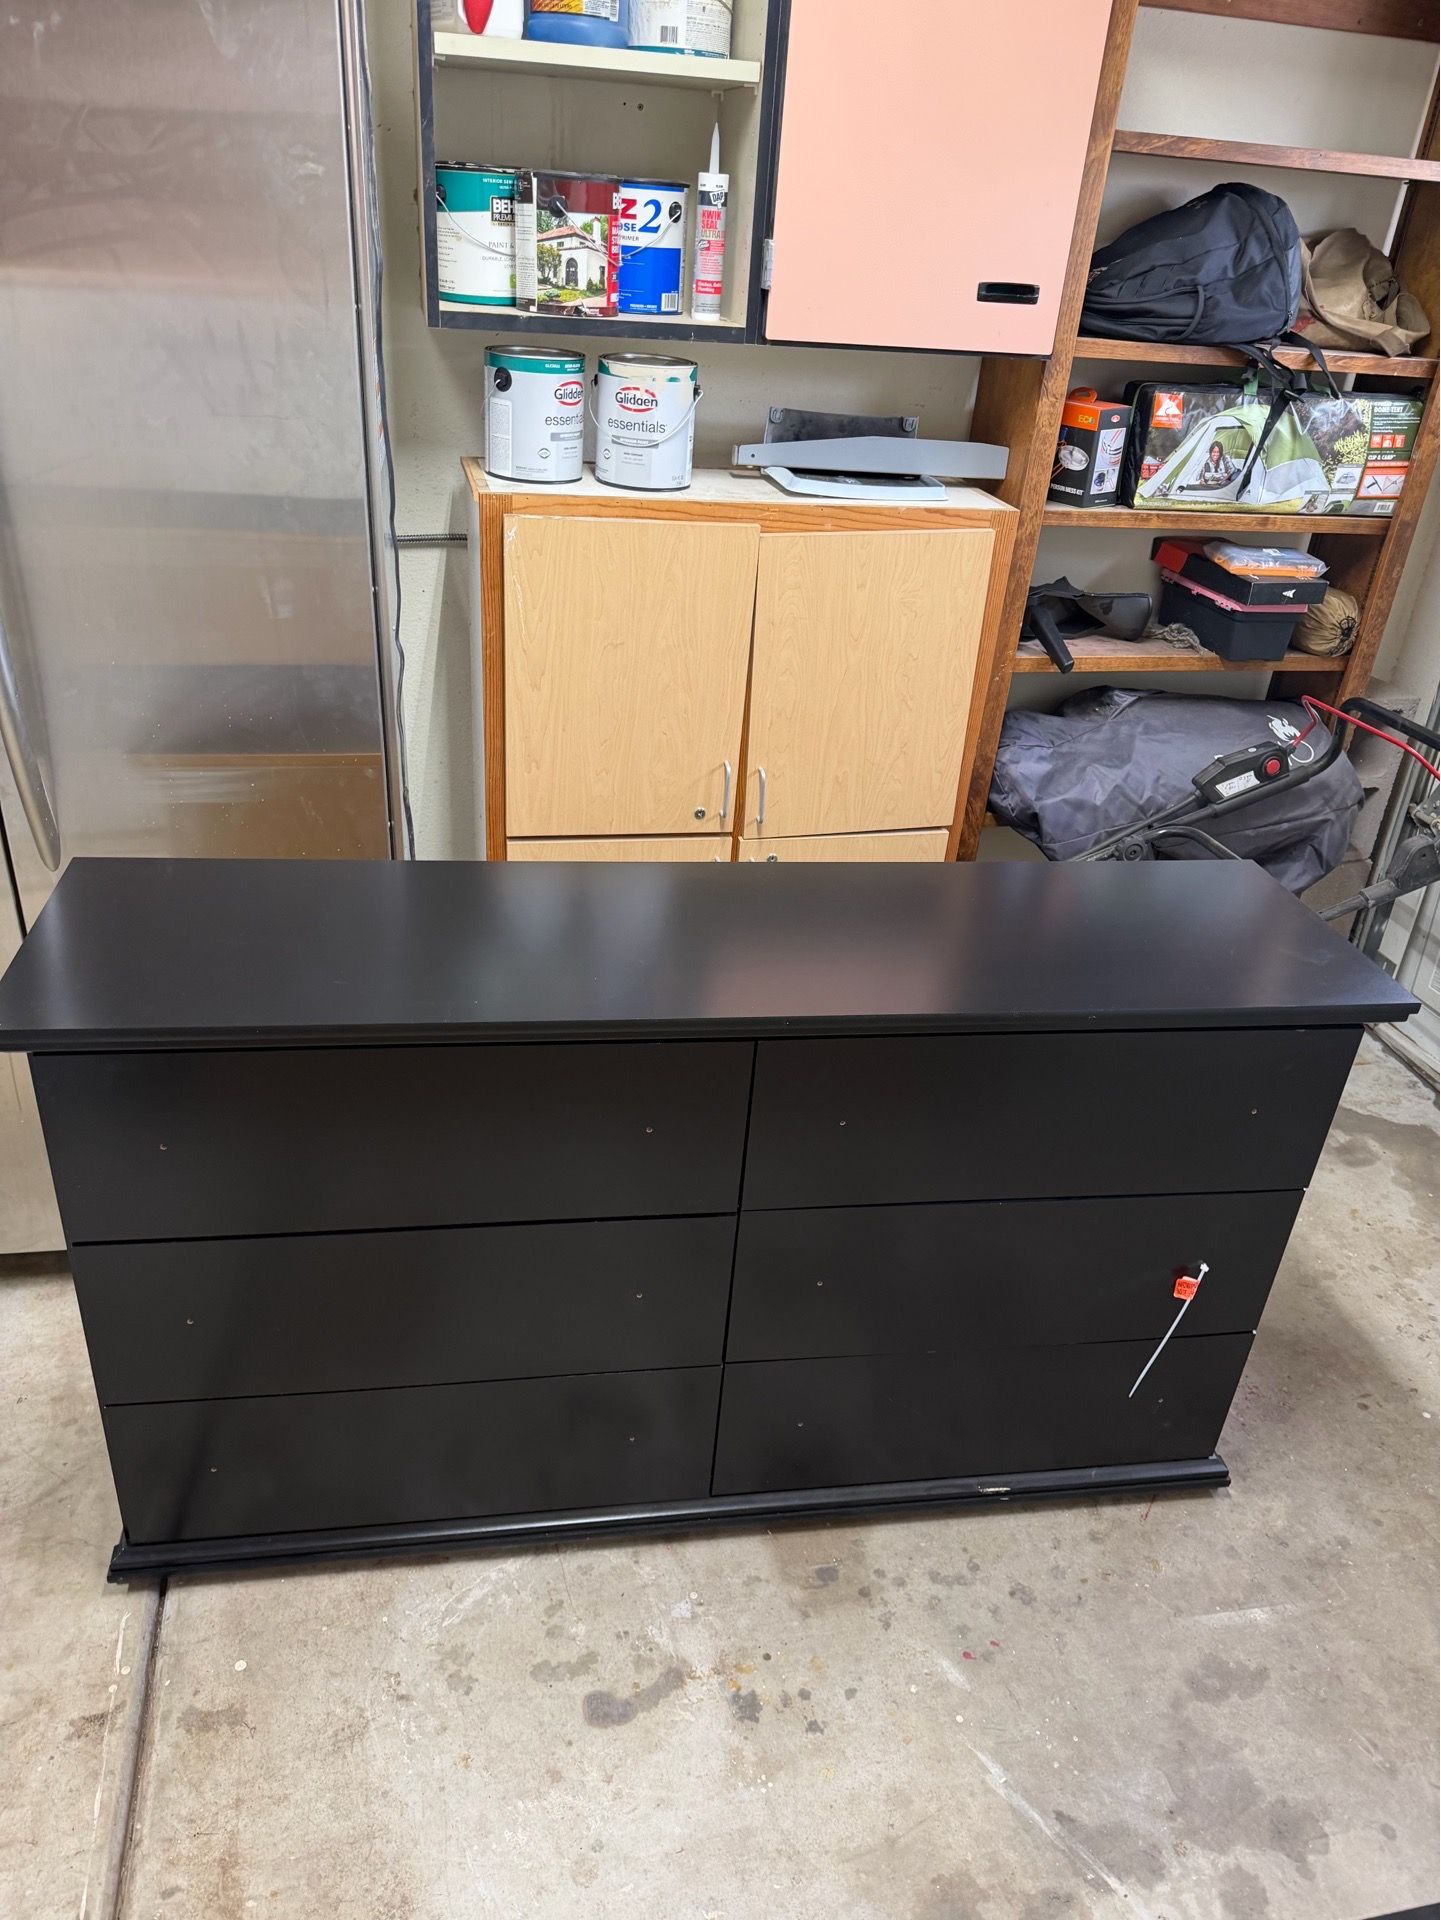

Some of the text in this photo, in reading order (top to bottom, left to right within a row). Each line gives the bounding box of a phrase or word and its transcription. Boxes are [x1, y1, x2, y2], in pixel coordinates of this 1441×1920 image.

[712, 192, 724, 202] DAP
[492, 199, 515, 214] BEH
[701, 220, 718, 230] SEAL
[700, 230, 721, 240] ULTRA
[615, 391, 658, 407] Glidden
[545, 414, 584, 426] essentia
[608, 418, 666, 433] essentials
[1065, 486, 1076, 494] MESS
